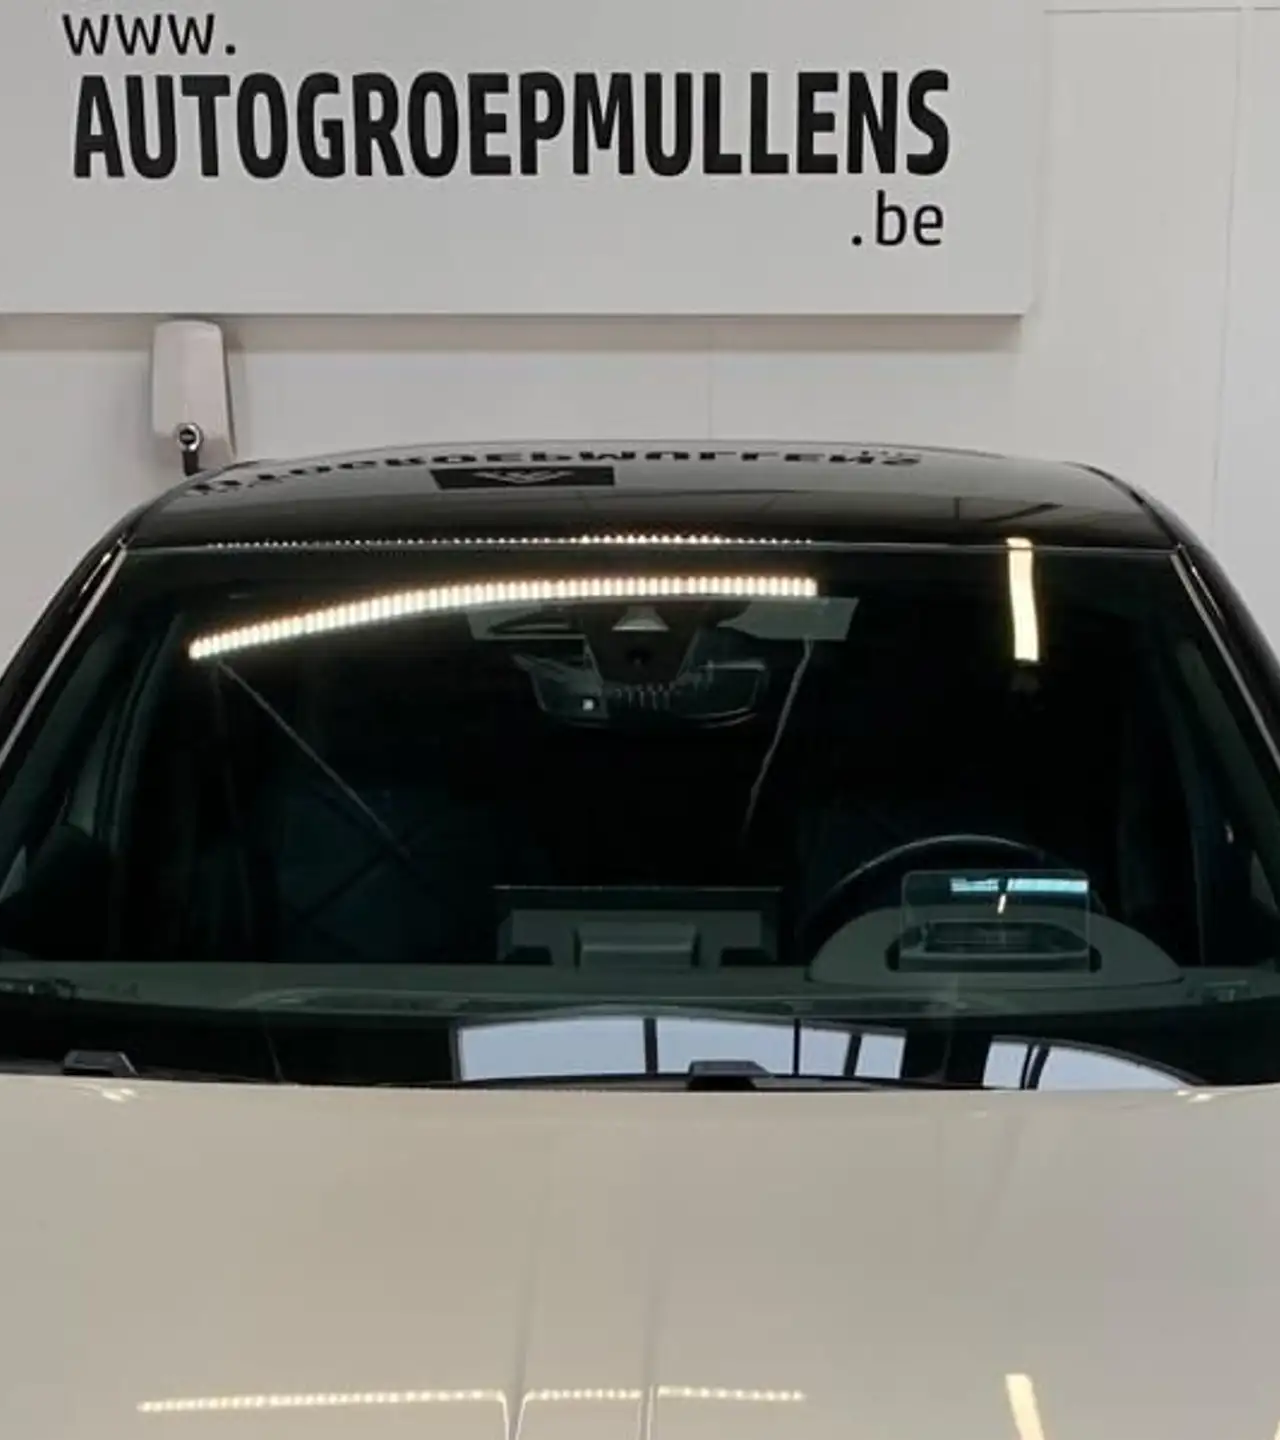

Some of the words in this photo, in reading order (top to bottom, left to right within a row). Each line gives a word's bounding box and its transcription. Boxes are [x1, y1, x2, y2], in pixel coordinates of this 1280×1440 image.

[61, 13, 236, 56] www.
[73, 70, 950, 180] AUTOGROEPMULLENS
[851, 189, 944, 247] .be
